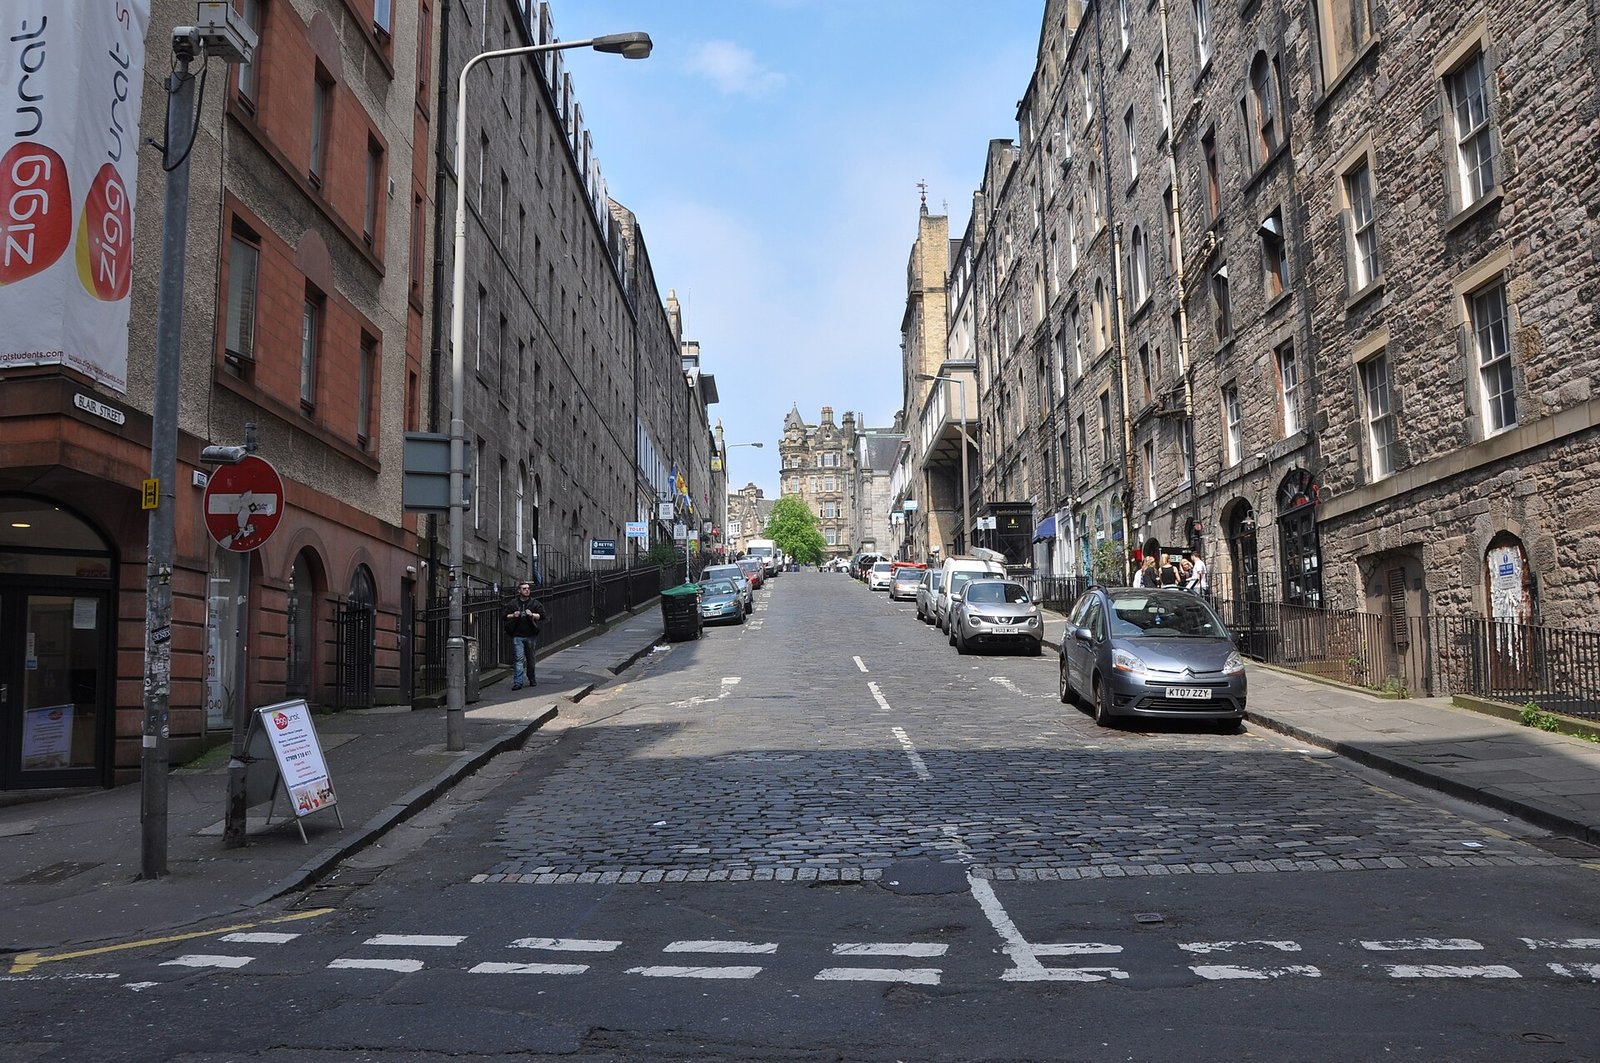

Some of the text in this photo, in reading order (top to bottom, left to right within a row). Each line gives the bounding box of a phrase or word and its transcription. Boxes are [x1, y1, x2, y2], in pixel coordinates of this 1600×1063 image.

[78, 396, 122, 423] BLAIR STREET
[1169, 689, 1190, 697] KT07
